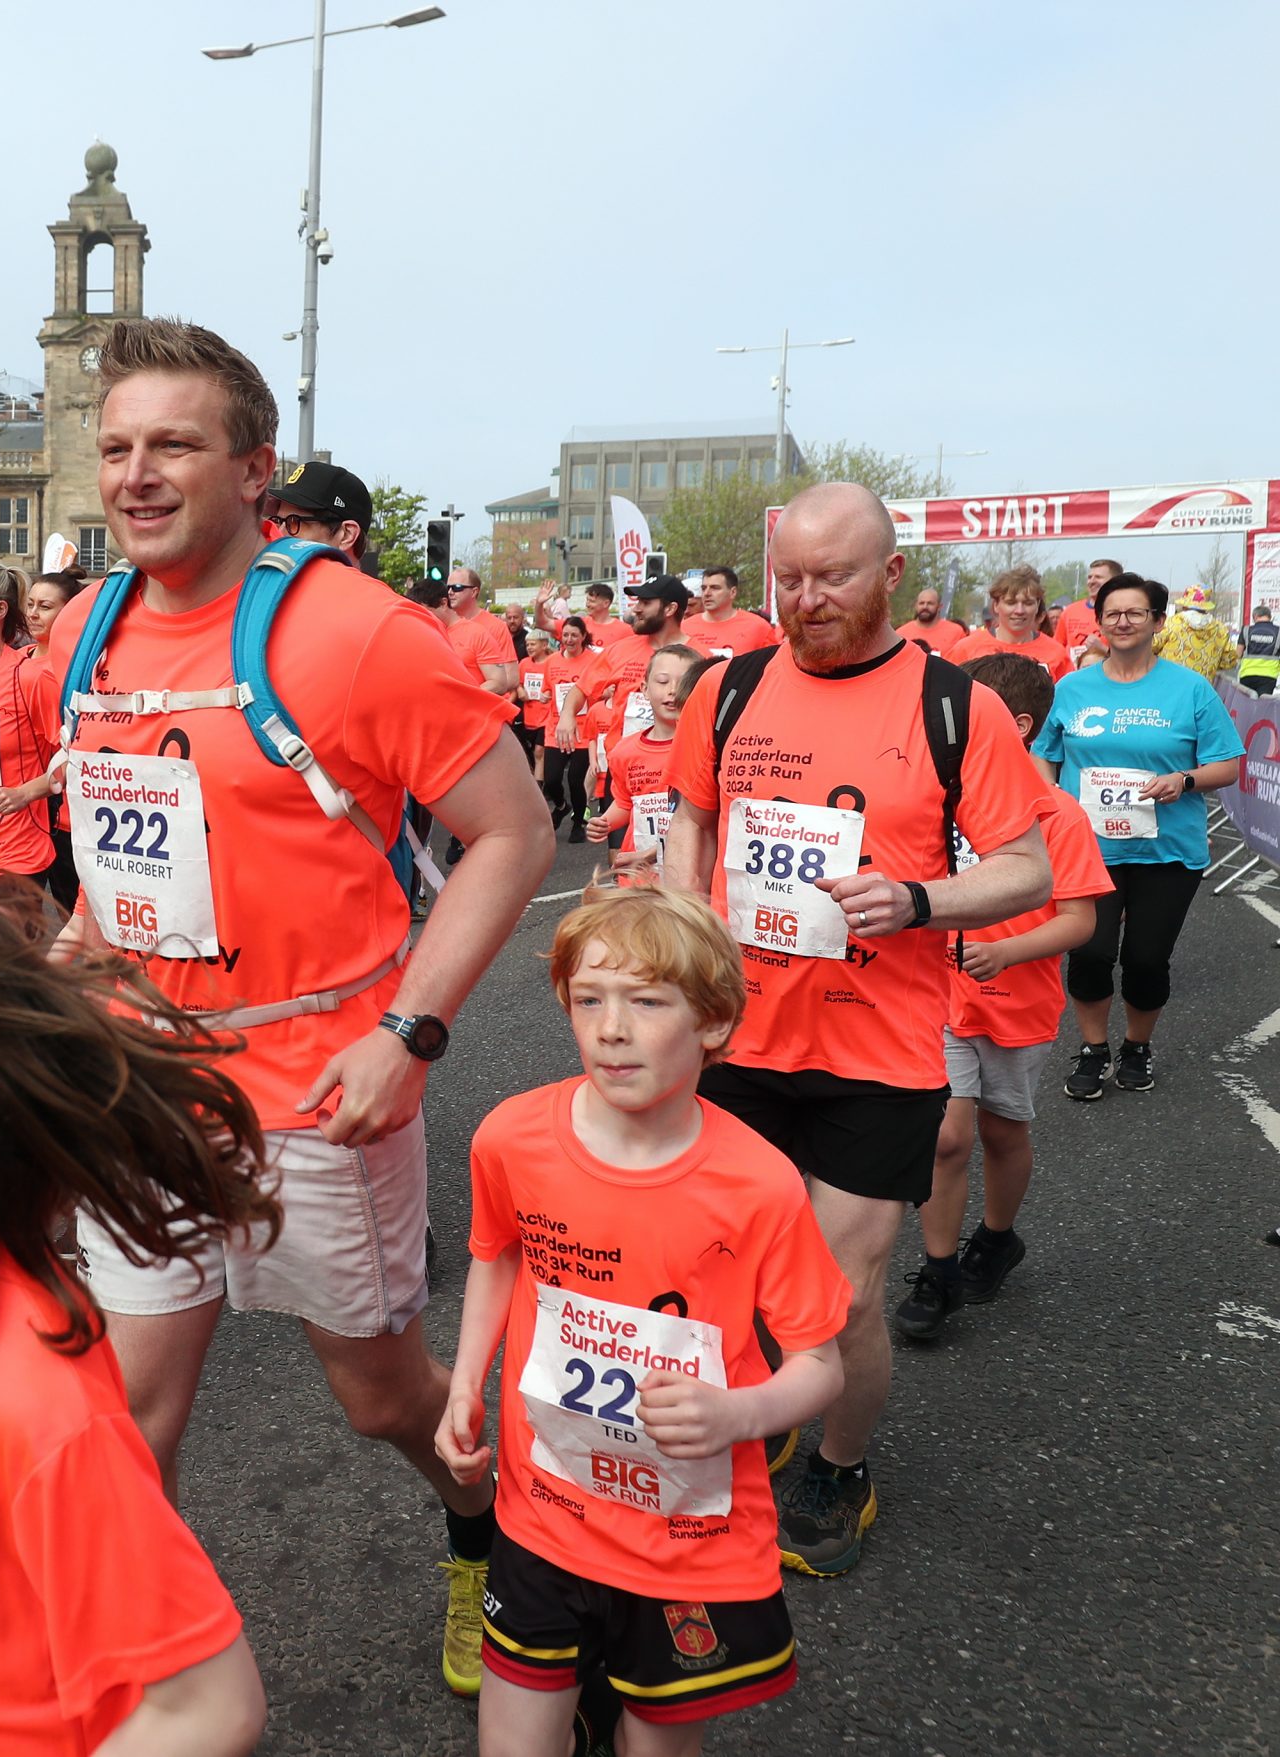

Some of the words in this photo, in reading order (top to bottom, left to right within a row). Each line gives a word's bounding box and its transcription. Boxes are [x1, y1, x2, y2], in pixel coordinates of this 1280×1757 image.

[961, 496, 1070, 538] START
[1173, 507, 1253, 518] SUNDERLAND
[1171, 517, 1208, 528] CITY
[1209, 516, 1253, 527] RUNS
[1114, 708, 1160, 718] CANCER
[1111, 725, 1128, 734] UK
[1113, 716, 1171, 729] RESEARCH
[732, 735, 773, 746] Active
[729, 750, 813, 766] Sunderland
[80, 760, 133, 782] Active
[726, 765, 746, 778] BIG
[749, 765, 766, 777] 3k
[770, 767, 803, 781] Run
[1091, 771, 1121, 779] Active
[726, 780, 753, 793] 2024
[1090, 778, 1146, 788] Sunderland
[80, 781, 179, 807] Sunderland
[640, 797, 668, 806] Active
[1100, 788, 1132, 806] 64
[744, 805, 796, 824] Active
[94, 806, 170, 861] 222
[744, 820, 840, 846] Sunderland
[1104, 820, 1131, 831] BIG
[96, 854, 125, 872] PAUL
[127, 860, 174, 880] ROBERT
[745, 839, 827, 885] 388
[955, 855, 974, 865] RGE
[763, 880, 794, 895] MIKE
[115, 890, 130, 898] Active
[130, 891, 157, 904] Sunderland
[115, 898, 158, 933] BIG
[771, 905, 800, 916] Sunderland
[754, 909, 799, 937] BIG
[118, 927, 133, 943] 3K
[134, 930, 159, 947] RUN
[753, 931, 769, 944] 3K
[770, 934, 797, 949] RUN
[823, 996, 876, 1010] Sunderland
[517, 1209, 568, 1235] Active
[519, 1228, 622, 1264] Sunderland
[522, 1244, 549, 1264] BIG
[549, 1254, 574, 1273] 3k
[575, 1260, 614, 1282] Run
[528, 1261, 562, 1289] 2024
[560, 1300, 638, 1338] Active
[560, 1323, 701, 1379] Sunderland
[559, 1357, 638, 1427] 22
[601, 1423, 638, 1444] TED
[591, 1453, 660, 1497] BIG
[530, 1487, 552, 1505] City
[592, 1480, 617, 1498] 3K
[619, 1488, 661, 1511] RUN
[667, 1518, 704, 1529] Active
[668, 1523, 730, 1540] Sunderland
